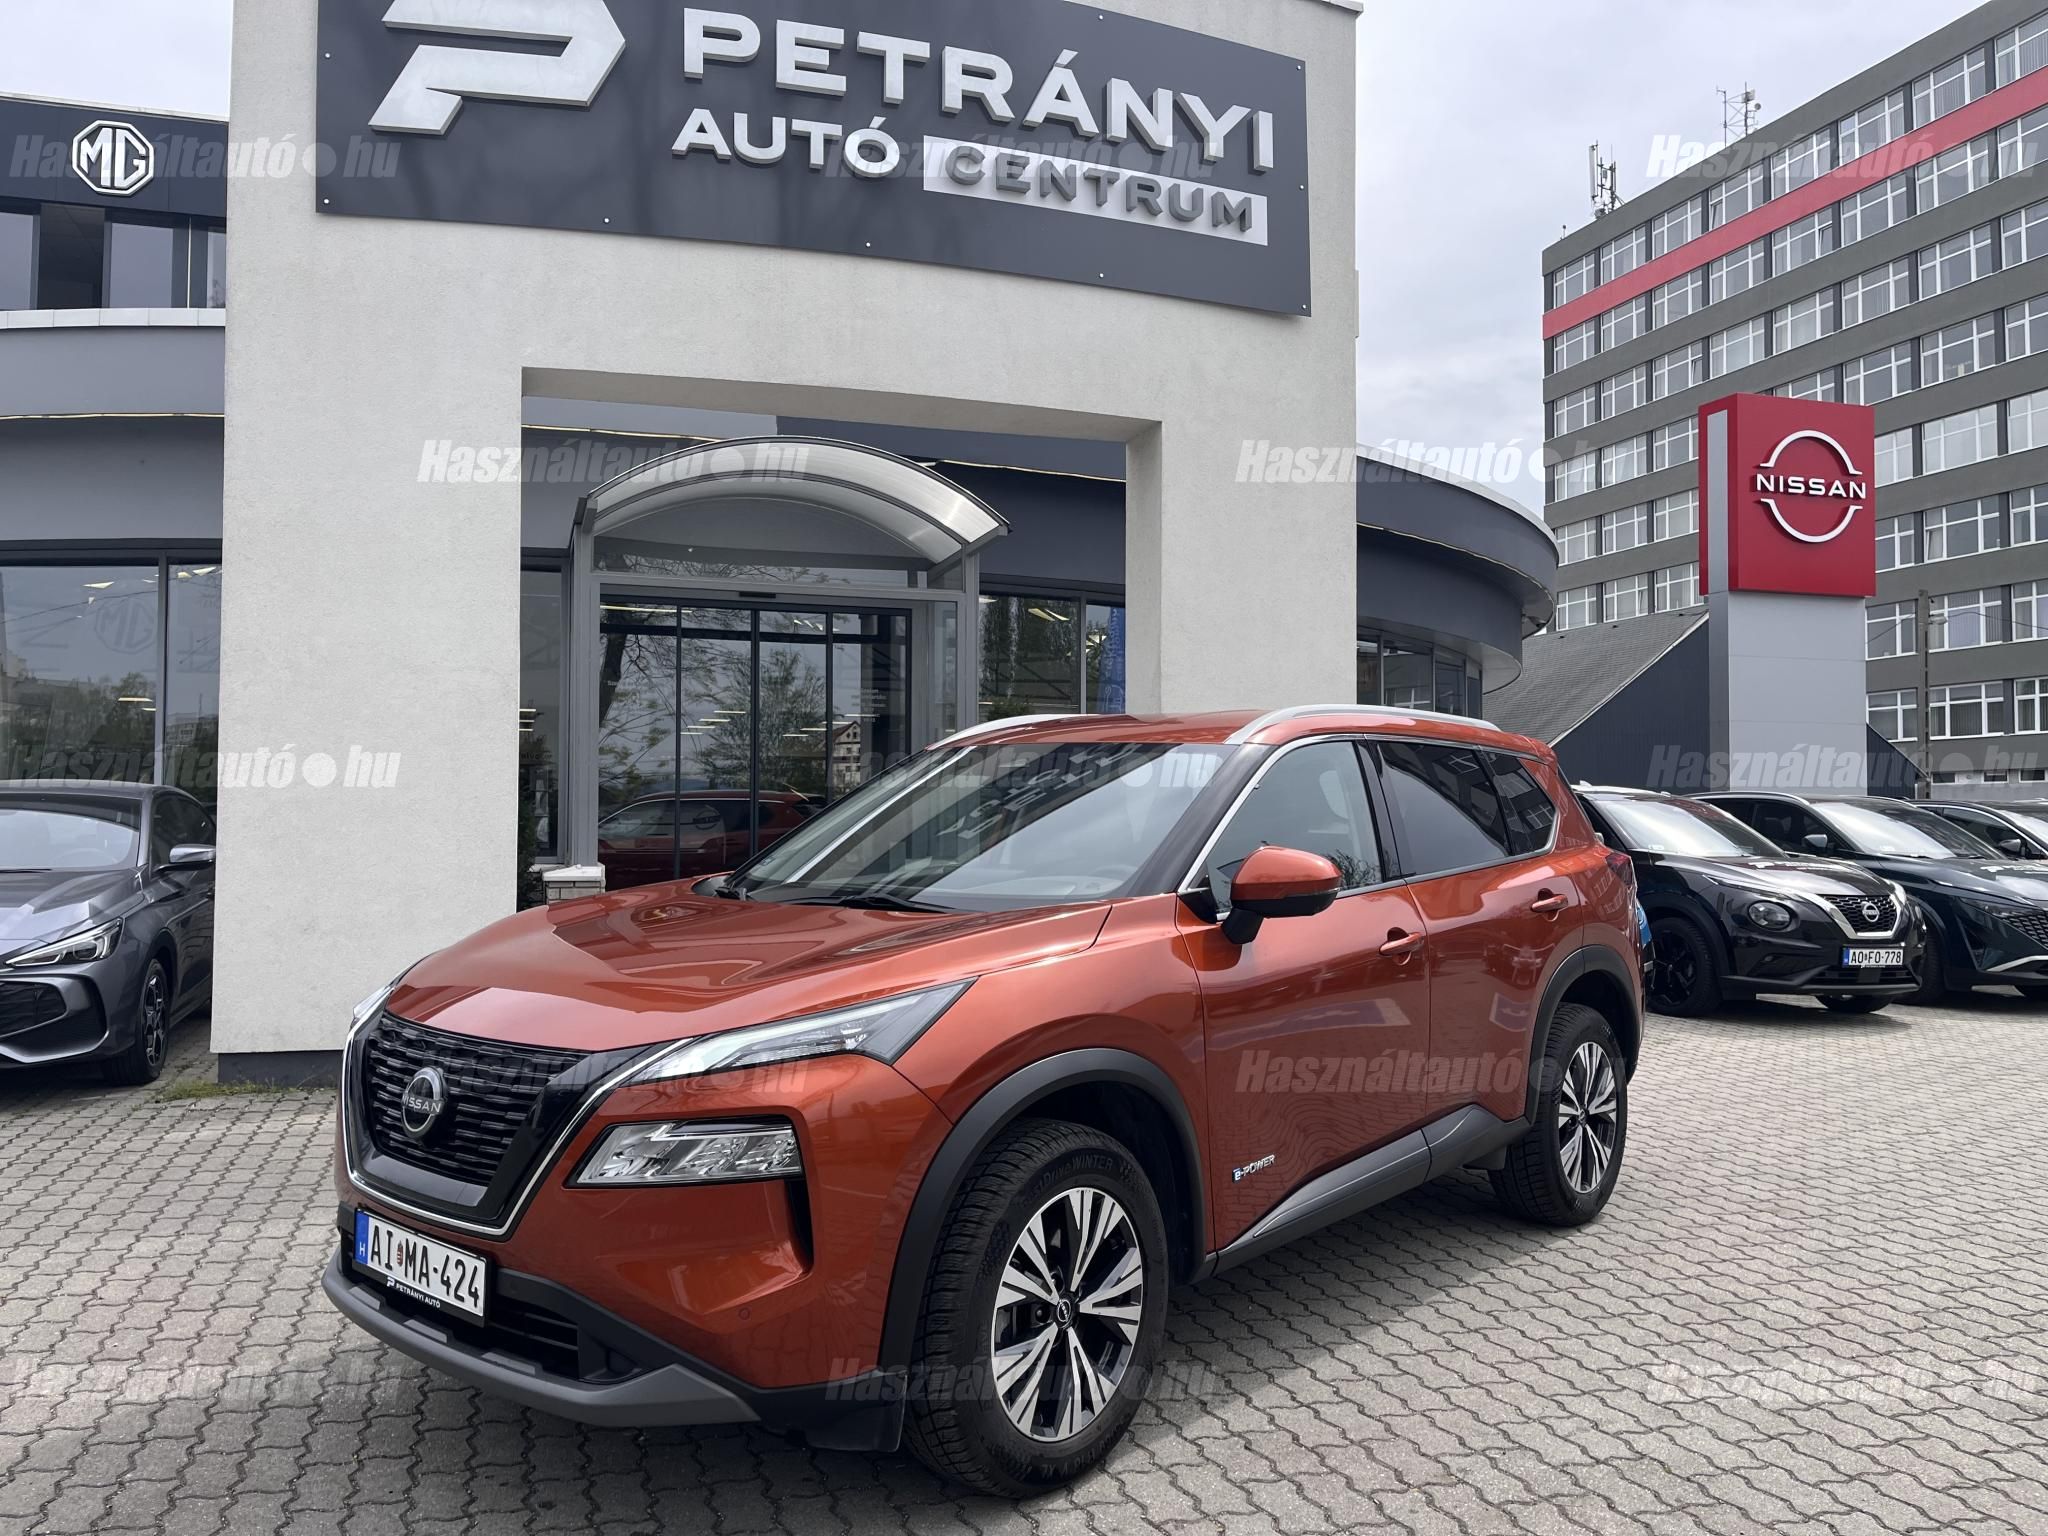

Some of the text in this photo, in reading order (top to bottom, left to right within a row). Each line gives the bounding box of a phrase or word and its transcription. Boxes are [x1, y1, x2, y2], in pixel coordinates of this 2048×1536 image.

[683, 7, 1274, 172] PETRÁNYI
[79, 126, 147, 189] MG
[671, 108, 1253, 232] AUTÓ CENTRUM
[1757, 473, 1866, 499] NISSAN
[402, 1093, 441, 1113] NISSAN
[1072, 1154, 1114, 1173] WINTER
[1233, 1154, 1276, 1181] e-POWER
[396, 1283, 424, 1302] PETRÁNYI
